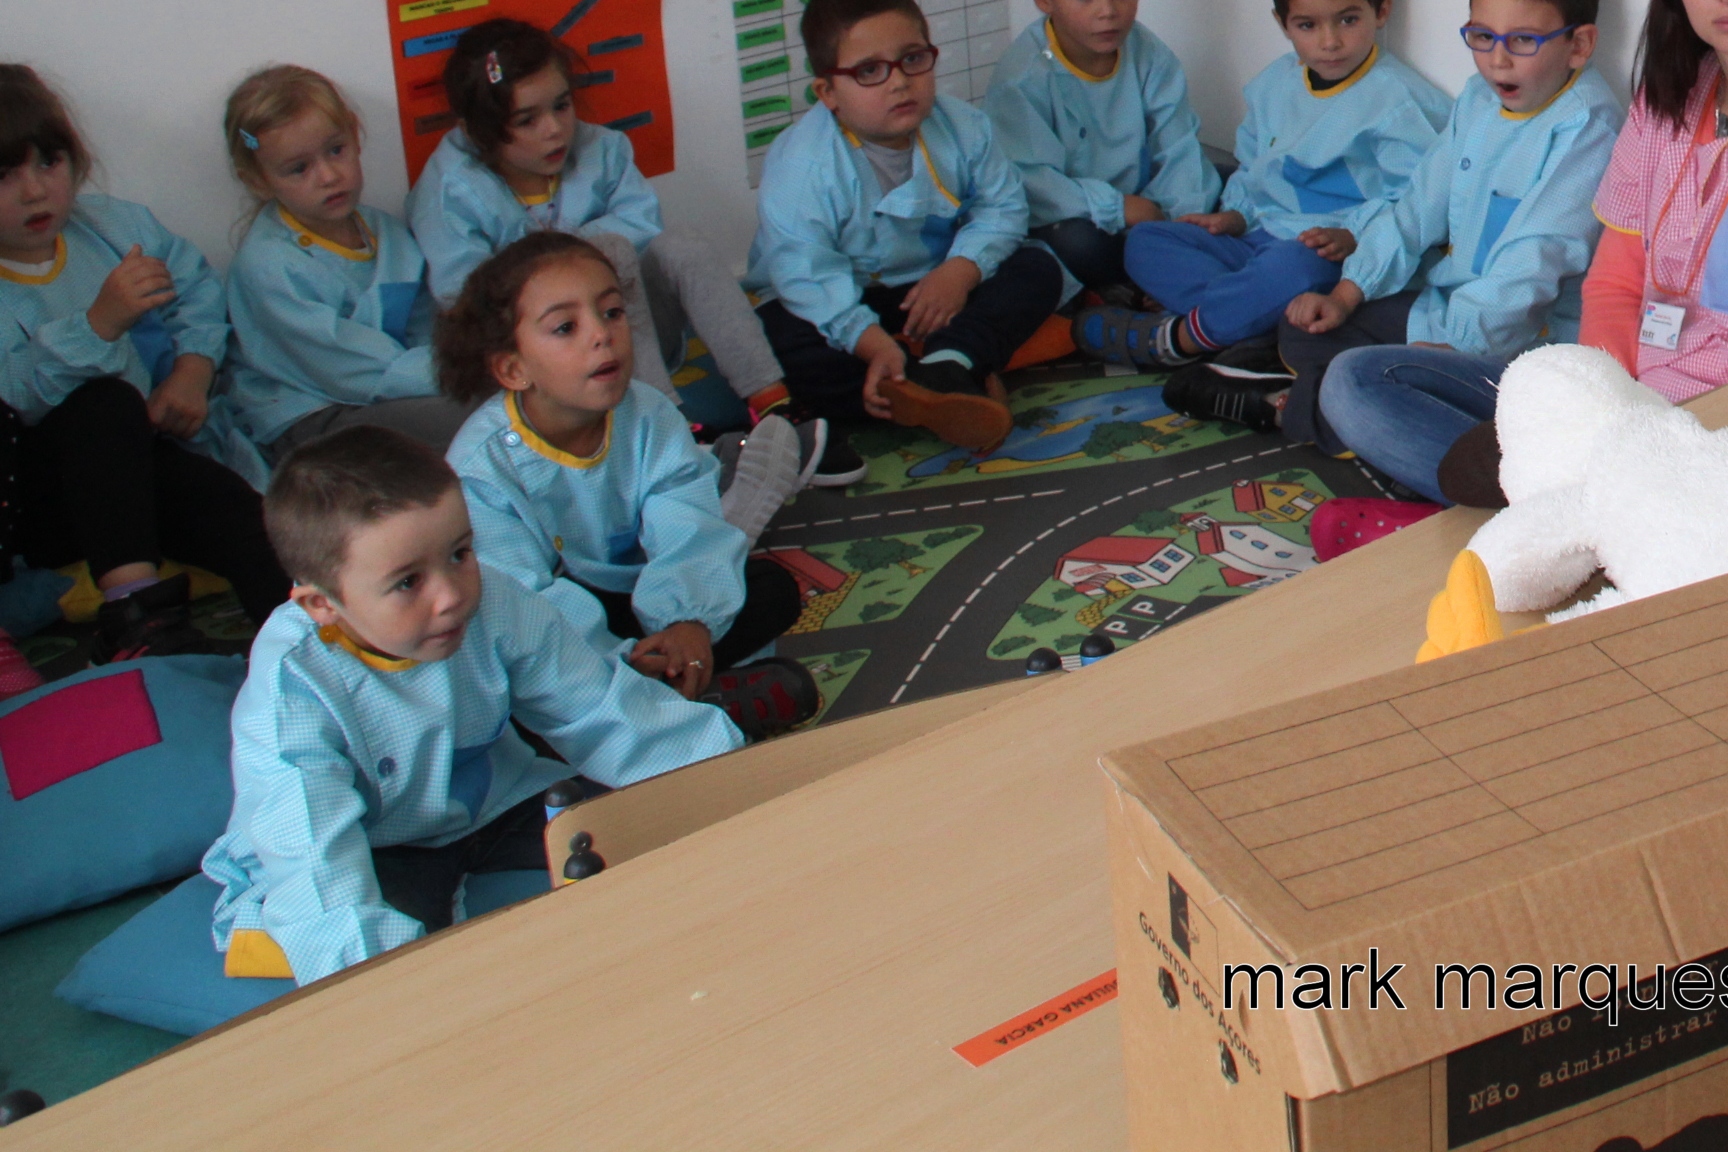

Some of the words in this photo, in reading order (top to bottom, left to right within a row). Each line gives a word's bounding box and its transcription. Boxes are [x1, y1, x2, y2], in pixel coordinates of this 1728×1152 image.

[1131, 600, 1156, 615] P
[1104, 620, 1129, 635] P
[1138, 911, 1190, 986] Governo
[1192, 980, 1215, 1018] dos
[1217, 1010, 1262, 1076] Açores
[994, 1010, 1060, 1046] GARCIA
[1467, 1080, 1520, 1115] Não
[1537, 1007, 1718, 1090] administrar
